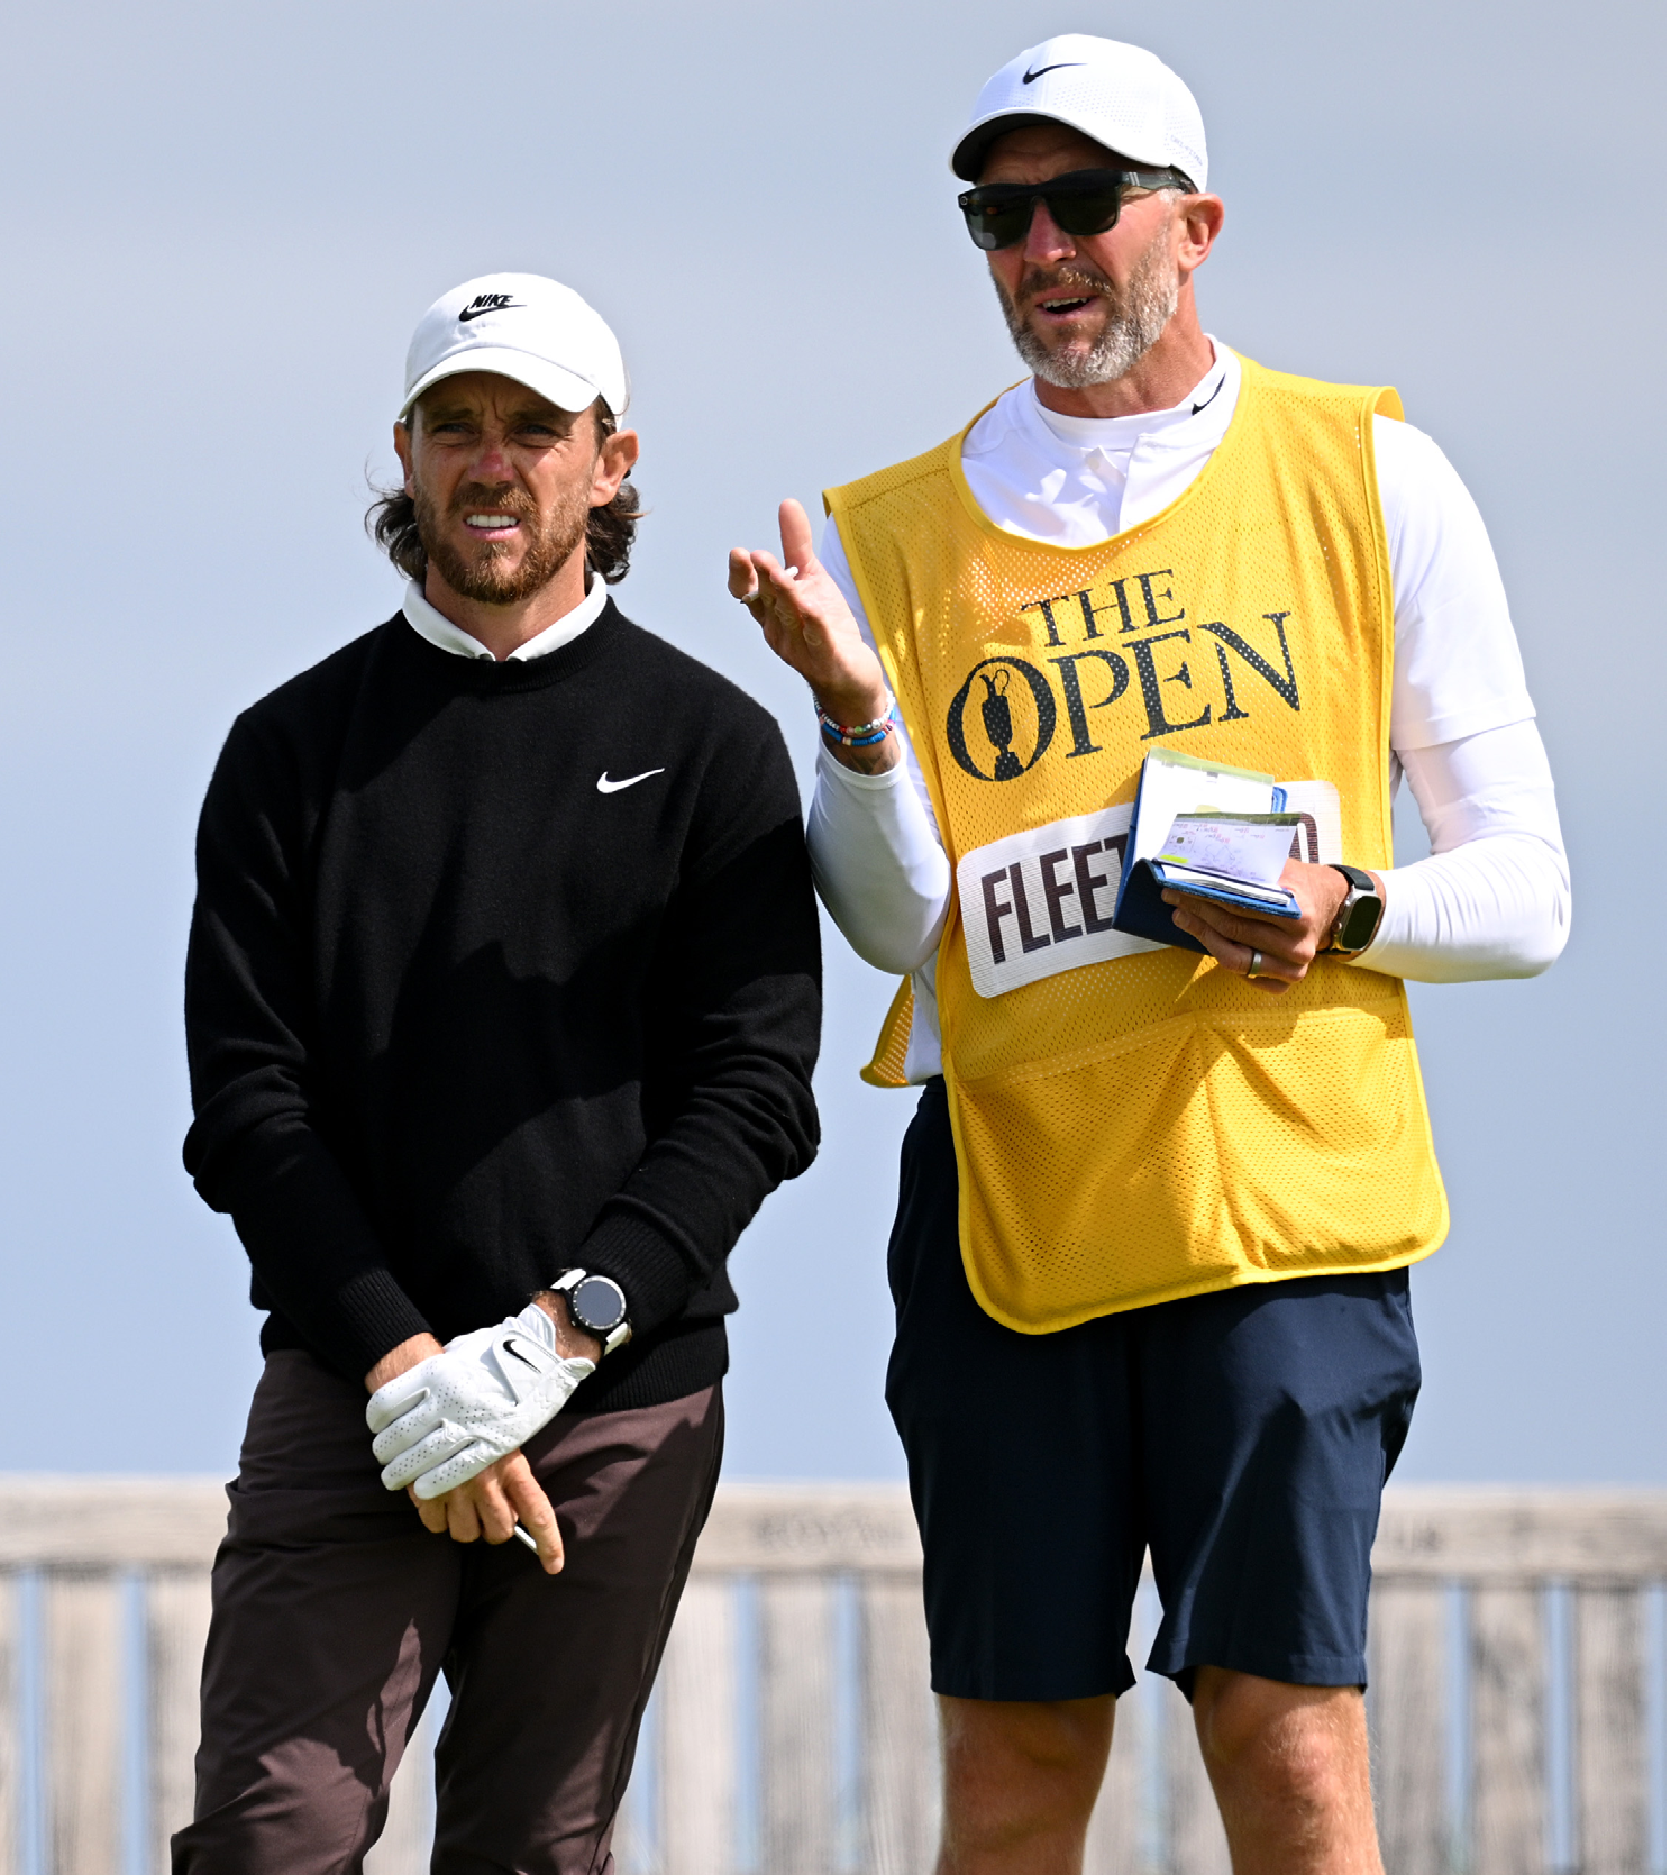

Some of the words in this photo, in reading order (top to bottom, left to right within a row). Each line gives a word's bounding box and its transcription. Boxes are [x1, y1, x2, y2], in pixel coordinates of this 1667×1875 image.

[470, 294, 514, 308] NIKE
[1021, 569, 1186, 647] THE
[947, 610, 1301, 782] OPEN
